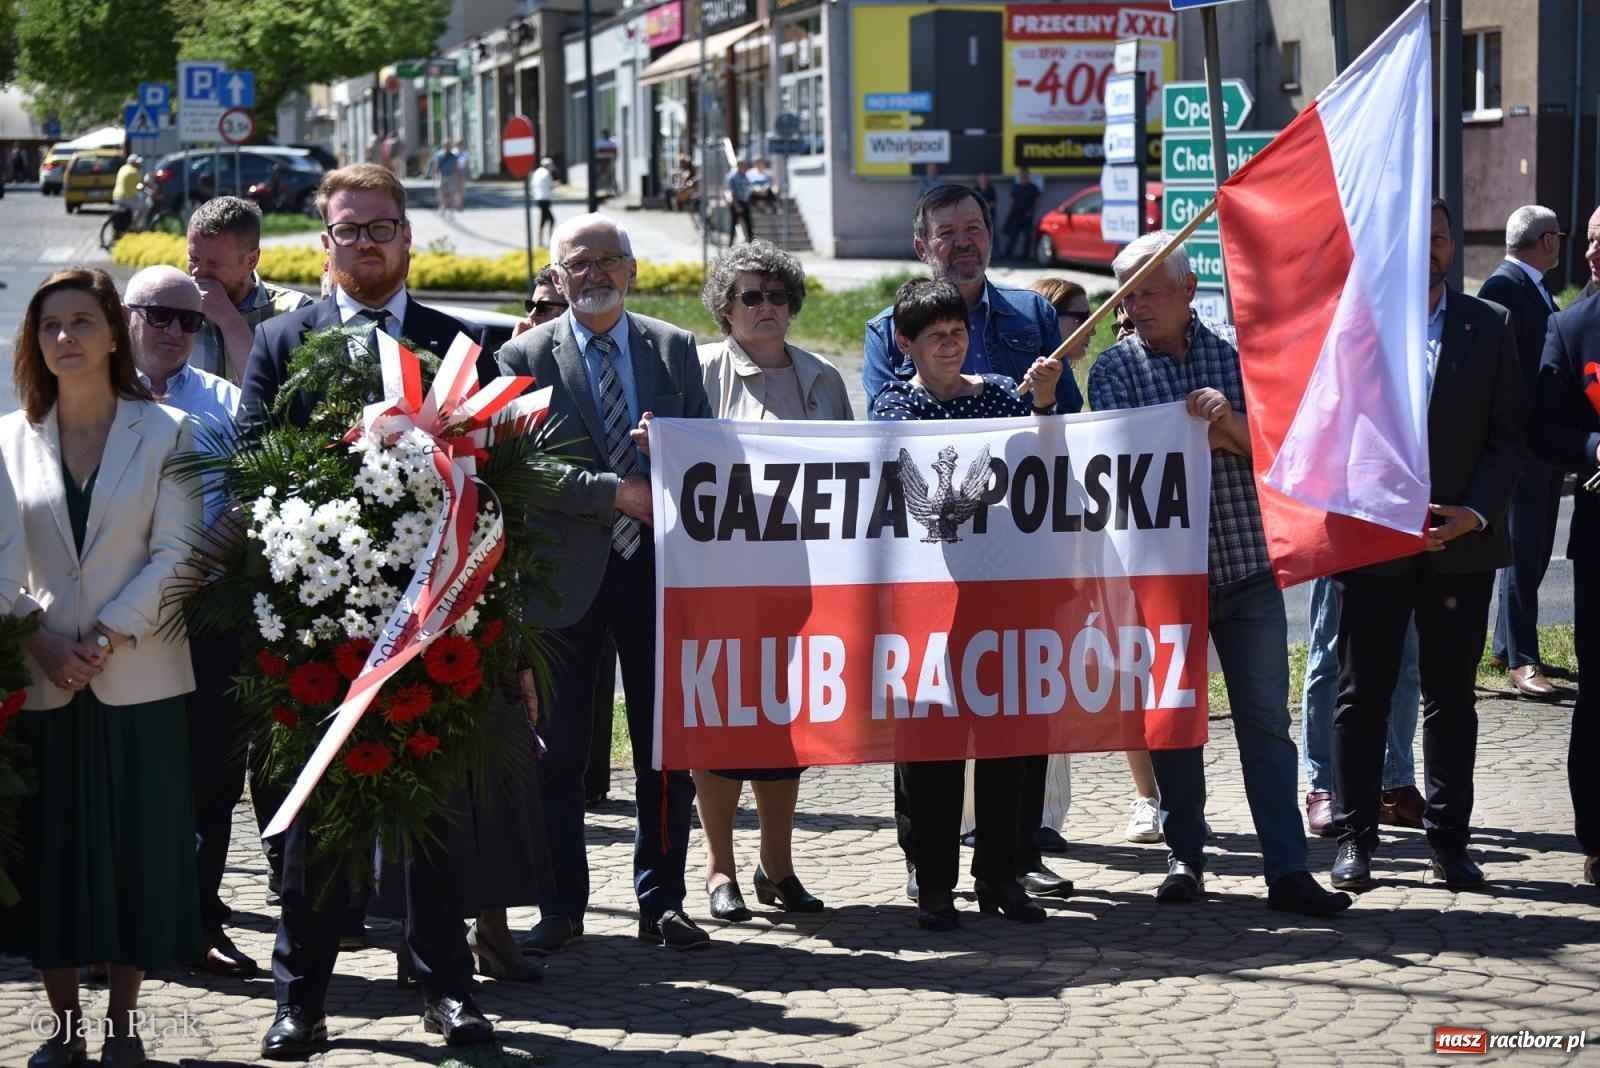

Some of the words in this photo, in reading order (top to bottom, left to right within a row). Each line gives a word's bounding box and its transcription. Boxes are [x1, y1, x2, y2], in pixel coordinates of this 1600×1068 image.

[1012, 14, 1116, 33] PRZECENY
[1124, 12, 1170, 38] XXL
[192, 70, 213, 97] P
[1174, 95, 1229, 126] Opoe
[870, 136, 945, 157] Whirlpool
[1023, 140, 1105, 158] mediaex
[1173, 146, 1253, 178] Chałpki
[1190, 251, 1221, 275] etra
[1199, 300, 1217, 317] tal
[680, 460, 910, 542] GAZETA
[972, 451, 1190, 535] POLSKA
[681, 634, 847, 728] KLUB
[871, 611, 1197, 719] RACIBÓRZ
